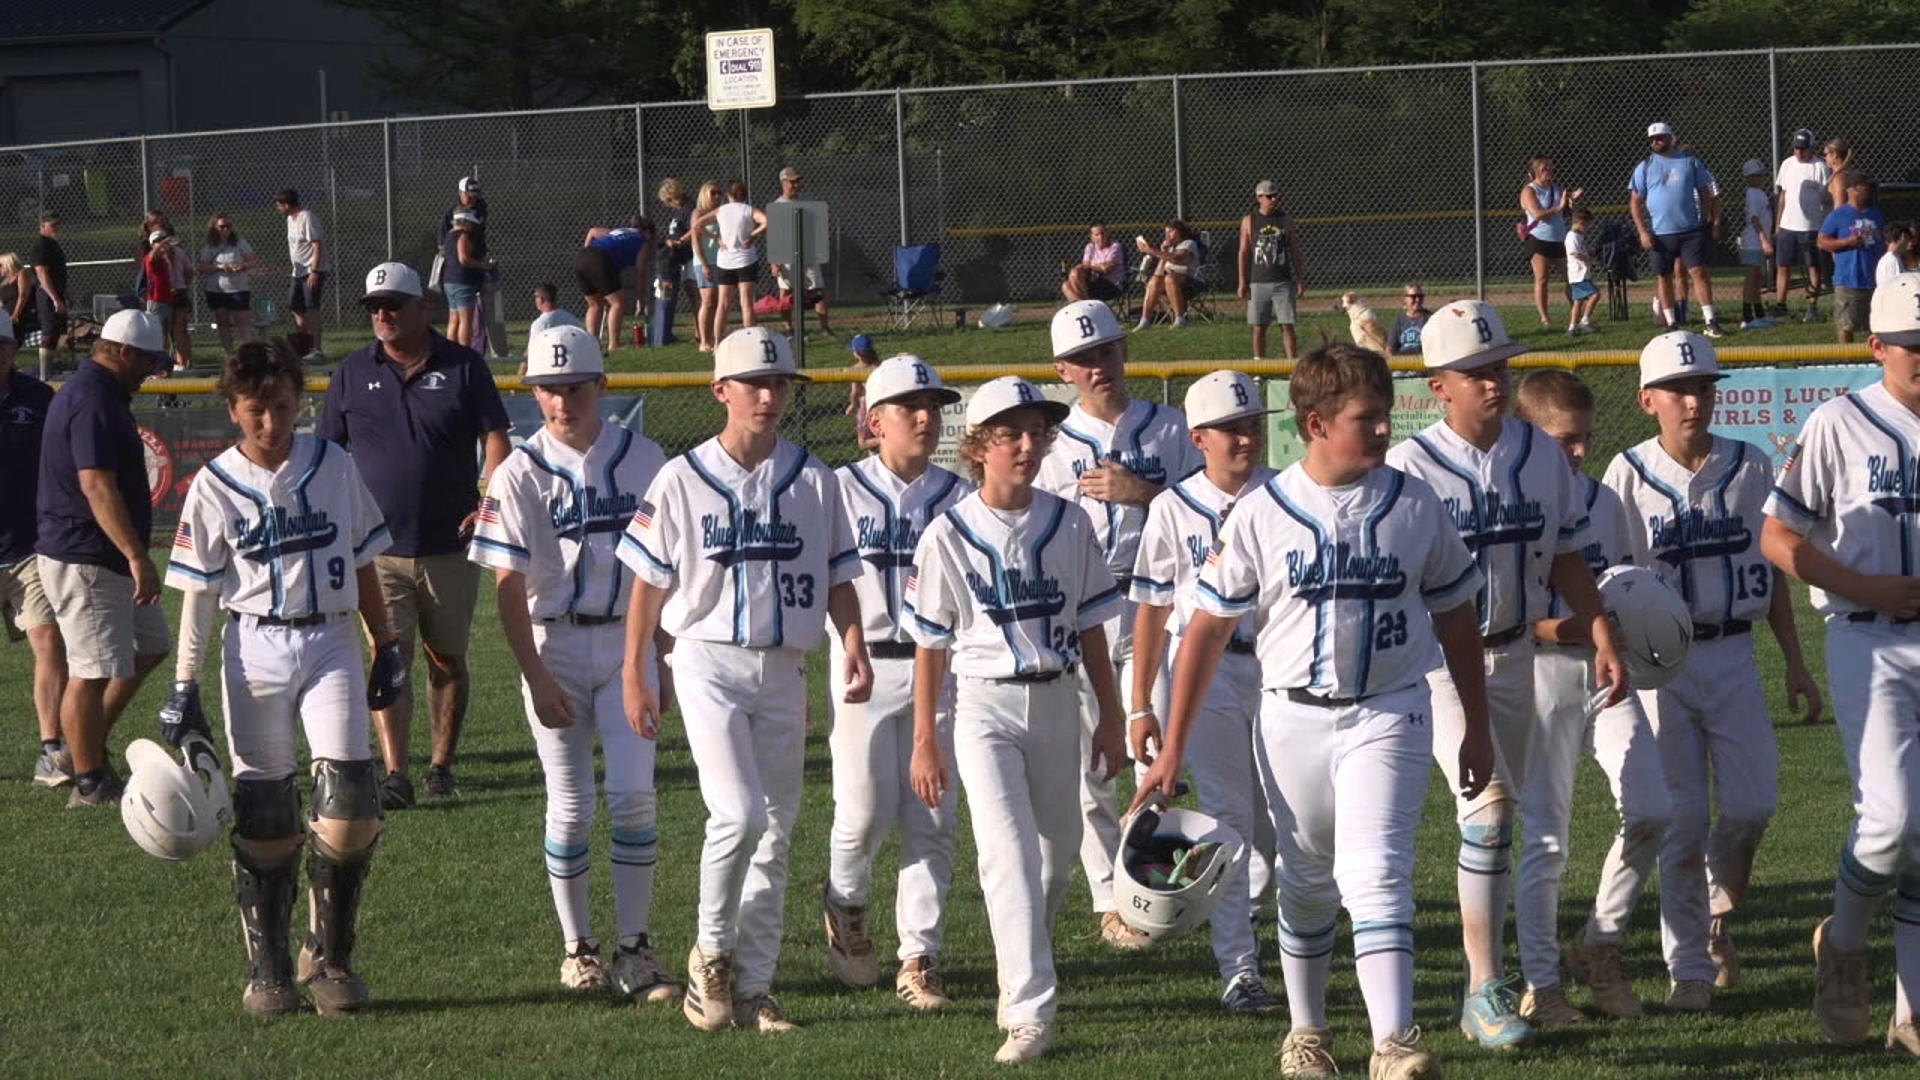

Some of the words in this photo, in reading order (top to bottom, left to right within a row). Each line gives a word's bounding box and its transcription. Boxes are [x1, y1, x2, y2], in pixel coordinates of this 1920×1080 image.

[716, 38, 724, 47] IN
[727, 36, 750, 47] CASE
[751, 35, 762, 46] OF
[713, 48, 766, 59] EMERGENCY
[731, 63, 748, 73] DIAL
[374, 269, 387, 285] B
[1075, 315, 1094, 338] B
[1471, 317, 1492, 343] B
[551, 344, 568, 367] B
[760, 339, 778, 363] B
[1677, 342, 1696, 366] B
[912, 363, 930, 385] B
[1012, 382, 1034, 403] B
[1229, 383, 1249, 407] B
[1715, 389, 1773, 406] GOOD
[1714, 409, 1771, 426] IRLS
[1783, 408, 1797, 425] &
[1868, 454, 1905, 493] Blue
[551, 497, 582, 528] Blue
[701, 513, 740, 551] Blue
[857, 515, 891, 551] Blue
[1186, 534, 1210, 567] Blu
[327, 556, 345, 590] 9
[1285, 549, 1325, 588] Blue
[1325, 540, 1400, 583] Mountain
[780, 572, 815, 610] 33
[1736, 563, 1768, 601] 13
